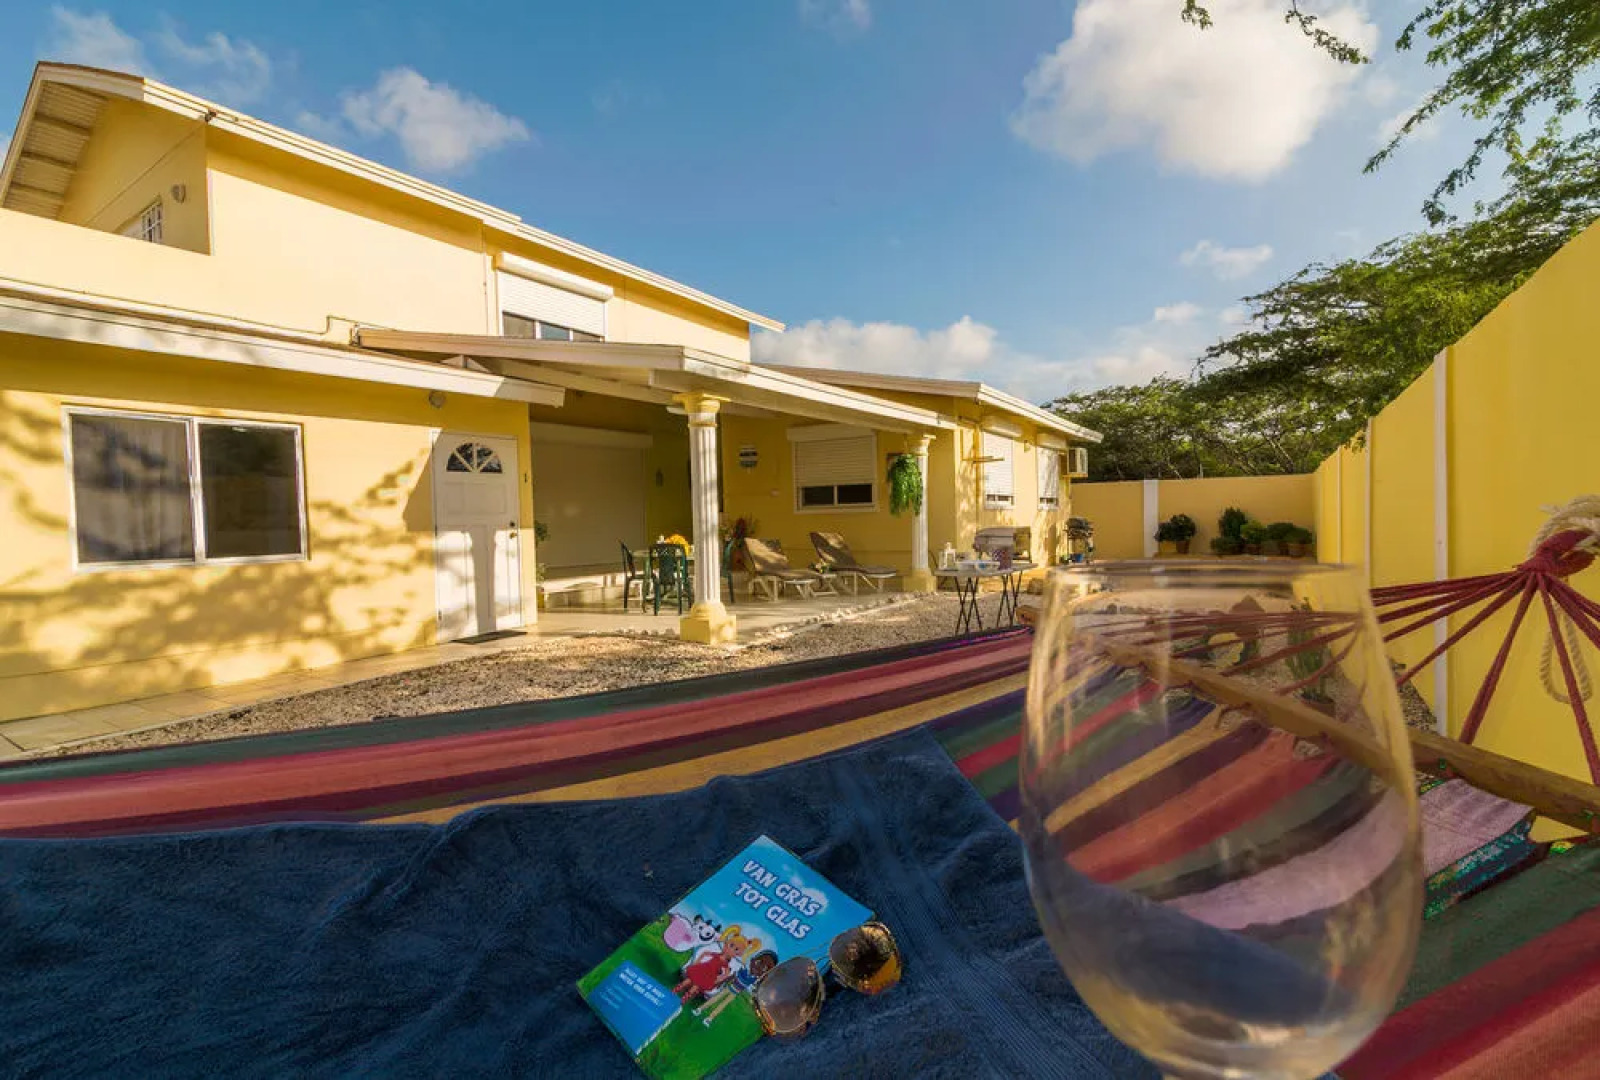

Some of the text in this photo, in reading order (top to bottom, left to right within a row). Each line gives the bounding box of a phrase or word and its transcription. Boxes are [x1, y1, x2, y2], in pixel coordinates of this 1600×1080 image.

[735, 882, 811, 938] TOT GLAS
[743, 860, 820, 916] VAN GRAS
